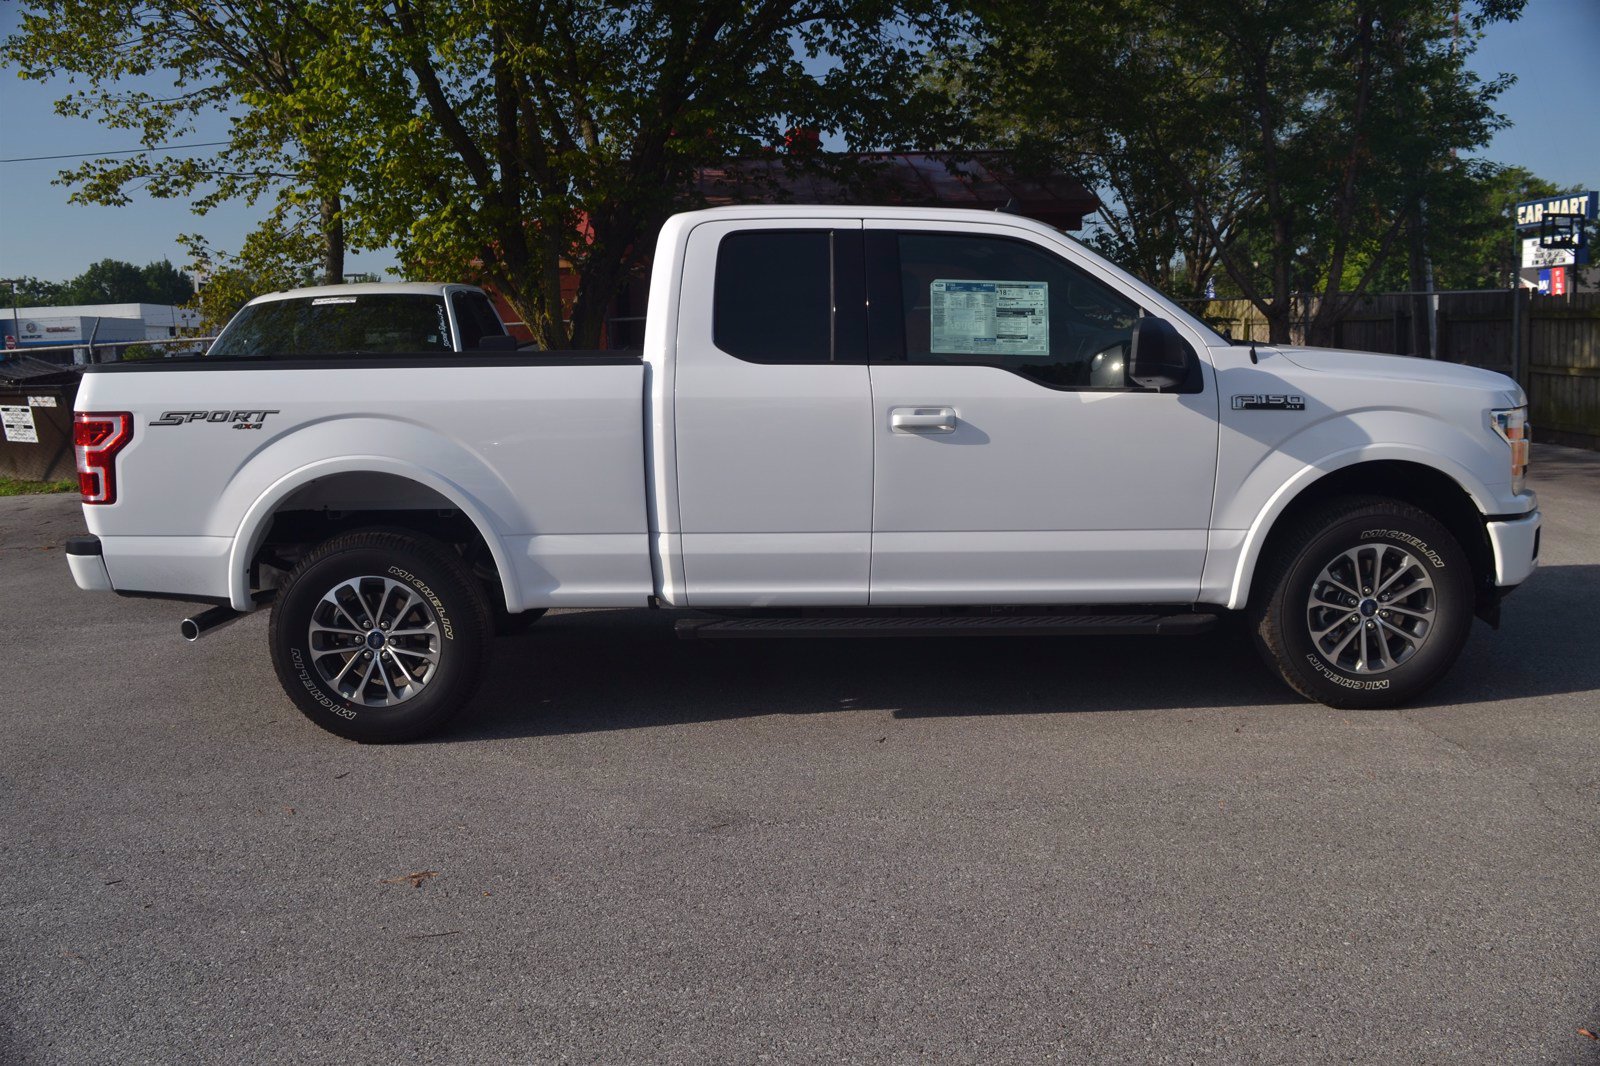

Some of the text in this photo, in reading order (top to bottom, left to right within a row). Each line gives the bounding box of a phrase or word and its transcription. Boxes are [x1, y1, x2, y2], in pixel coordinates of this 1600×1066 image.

[1517, 196, 1589, 224] CAR-MART
[148, 409, 281, 427] SPORT
[1360, 529, 1445, 568] MICHELIN
[388, 565, 454, 640] MICHELIN
[290, 647, 357, 721] MICHELIN
[1306, 652, 1390, 691] MICHELIN
